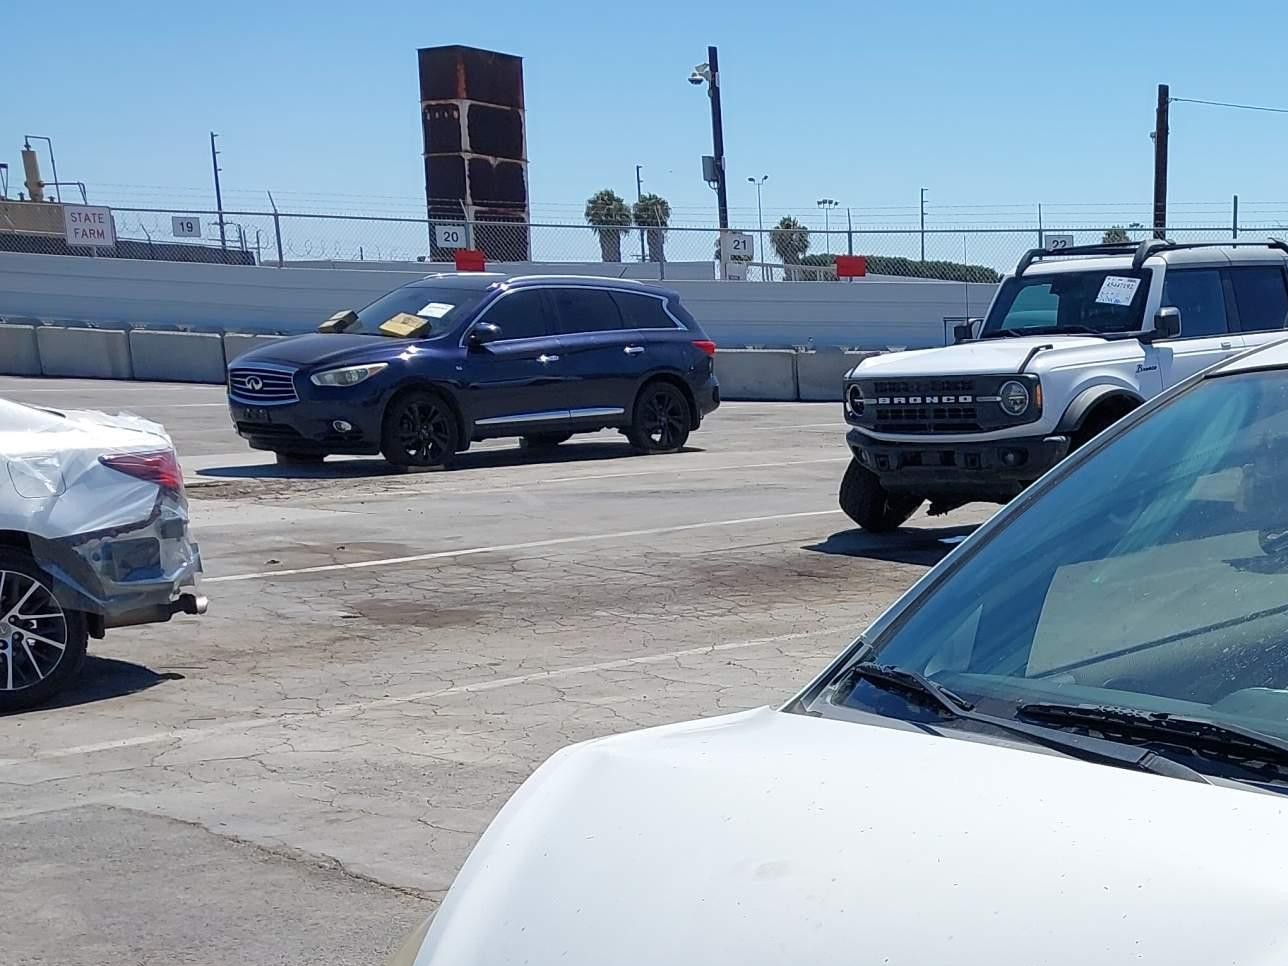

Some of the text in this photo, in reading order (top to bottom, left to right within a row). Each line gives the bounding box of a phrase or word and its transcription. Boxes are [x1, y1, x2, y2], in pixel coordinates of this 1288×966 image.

[70, 212, 105, 224] STATE
[179, 221, 193, 233] 19
[73, 227, 105, 240] FARM
[443, 231, 459, 243] 20
[732, 239, 747, 250] 21
[1052, 239, 1067, 249] 22
[878, 395, 973, 404] BRONCO
